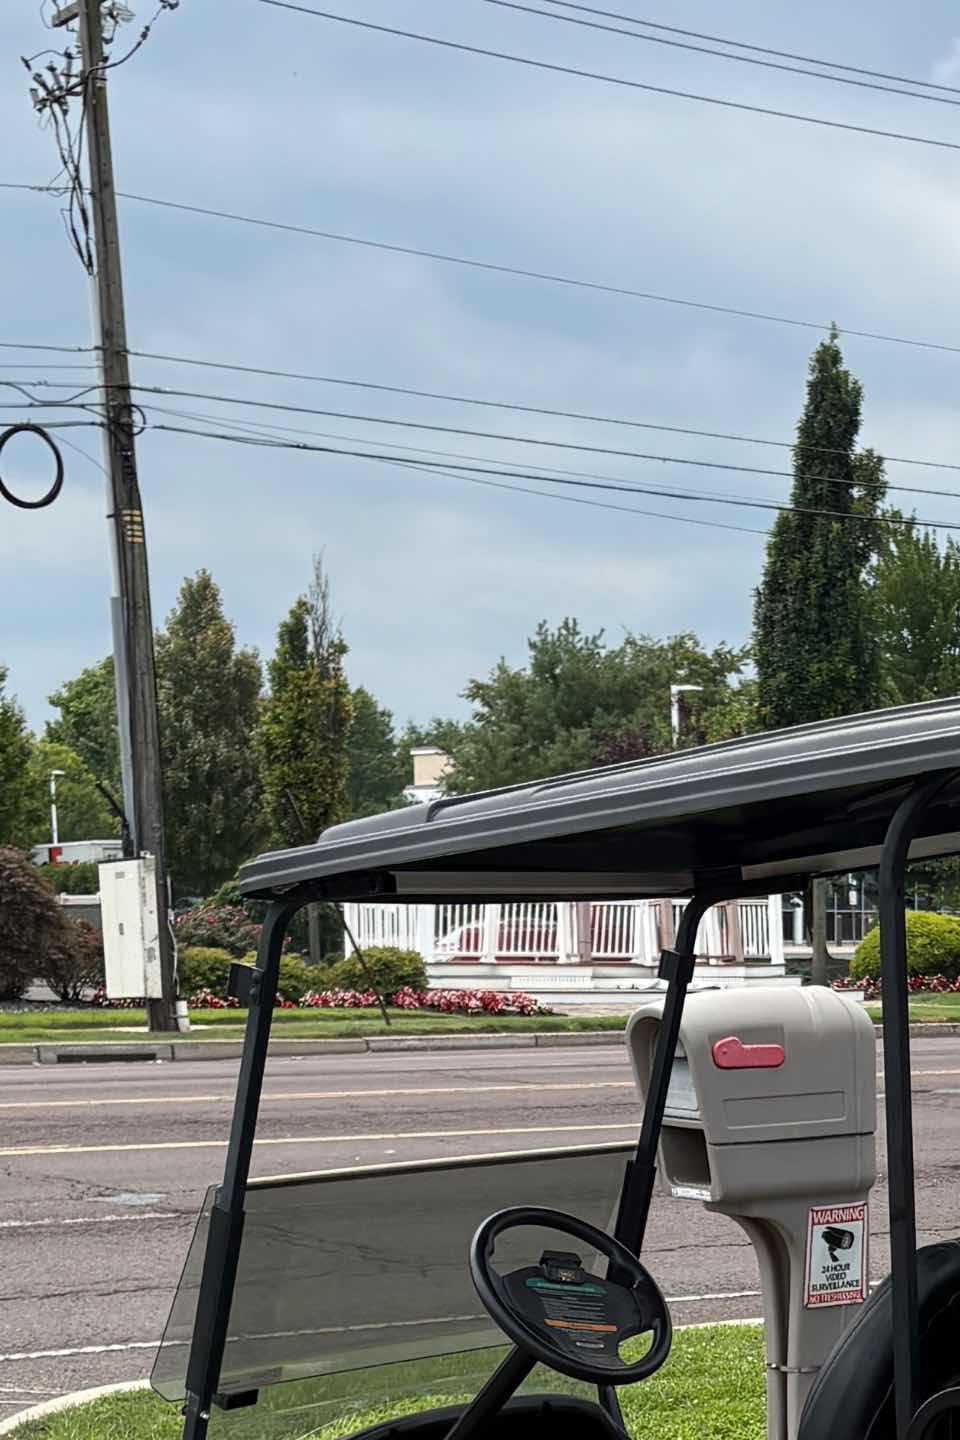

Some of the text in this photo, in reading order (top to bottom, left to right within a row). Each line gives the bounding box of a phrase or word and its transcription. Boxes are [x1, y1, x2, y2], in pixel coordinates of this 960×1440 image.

[813, 1206, 864, 1224] WARNING
[821, 1263, 850, 1274] 24 HOUR
[825, 1271, 847, 1281] VIDEO
[811, 1279, 860, 1291] SURVEILLANCE
